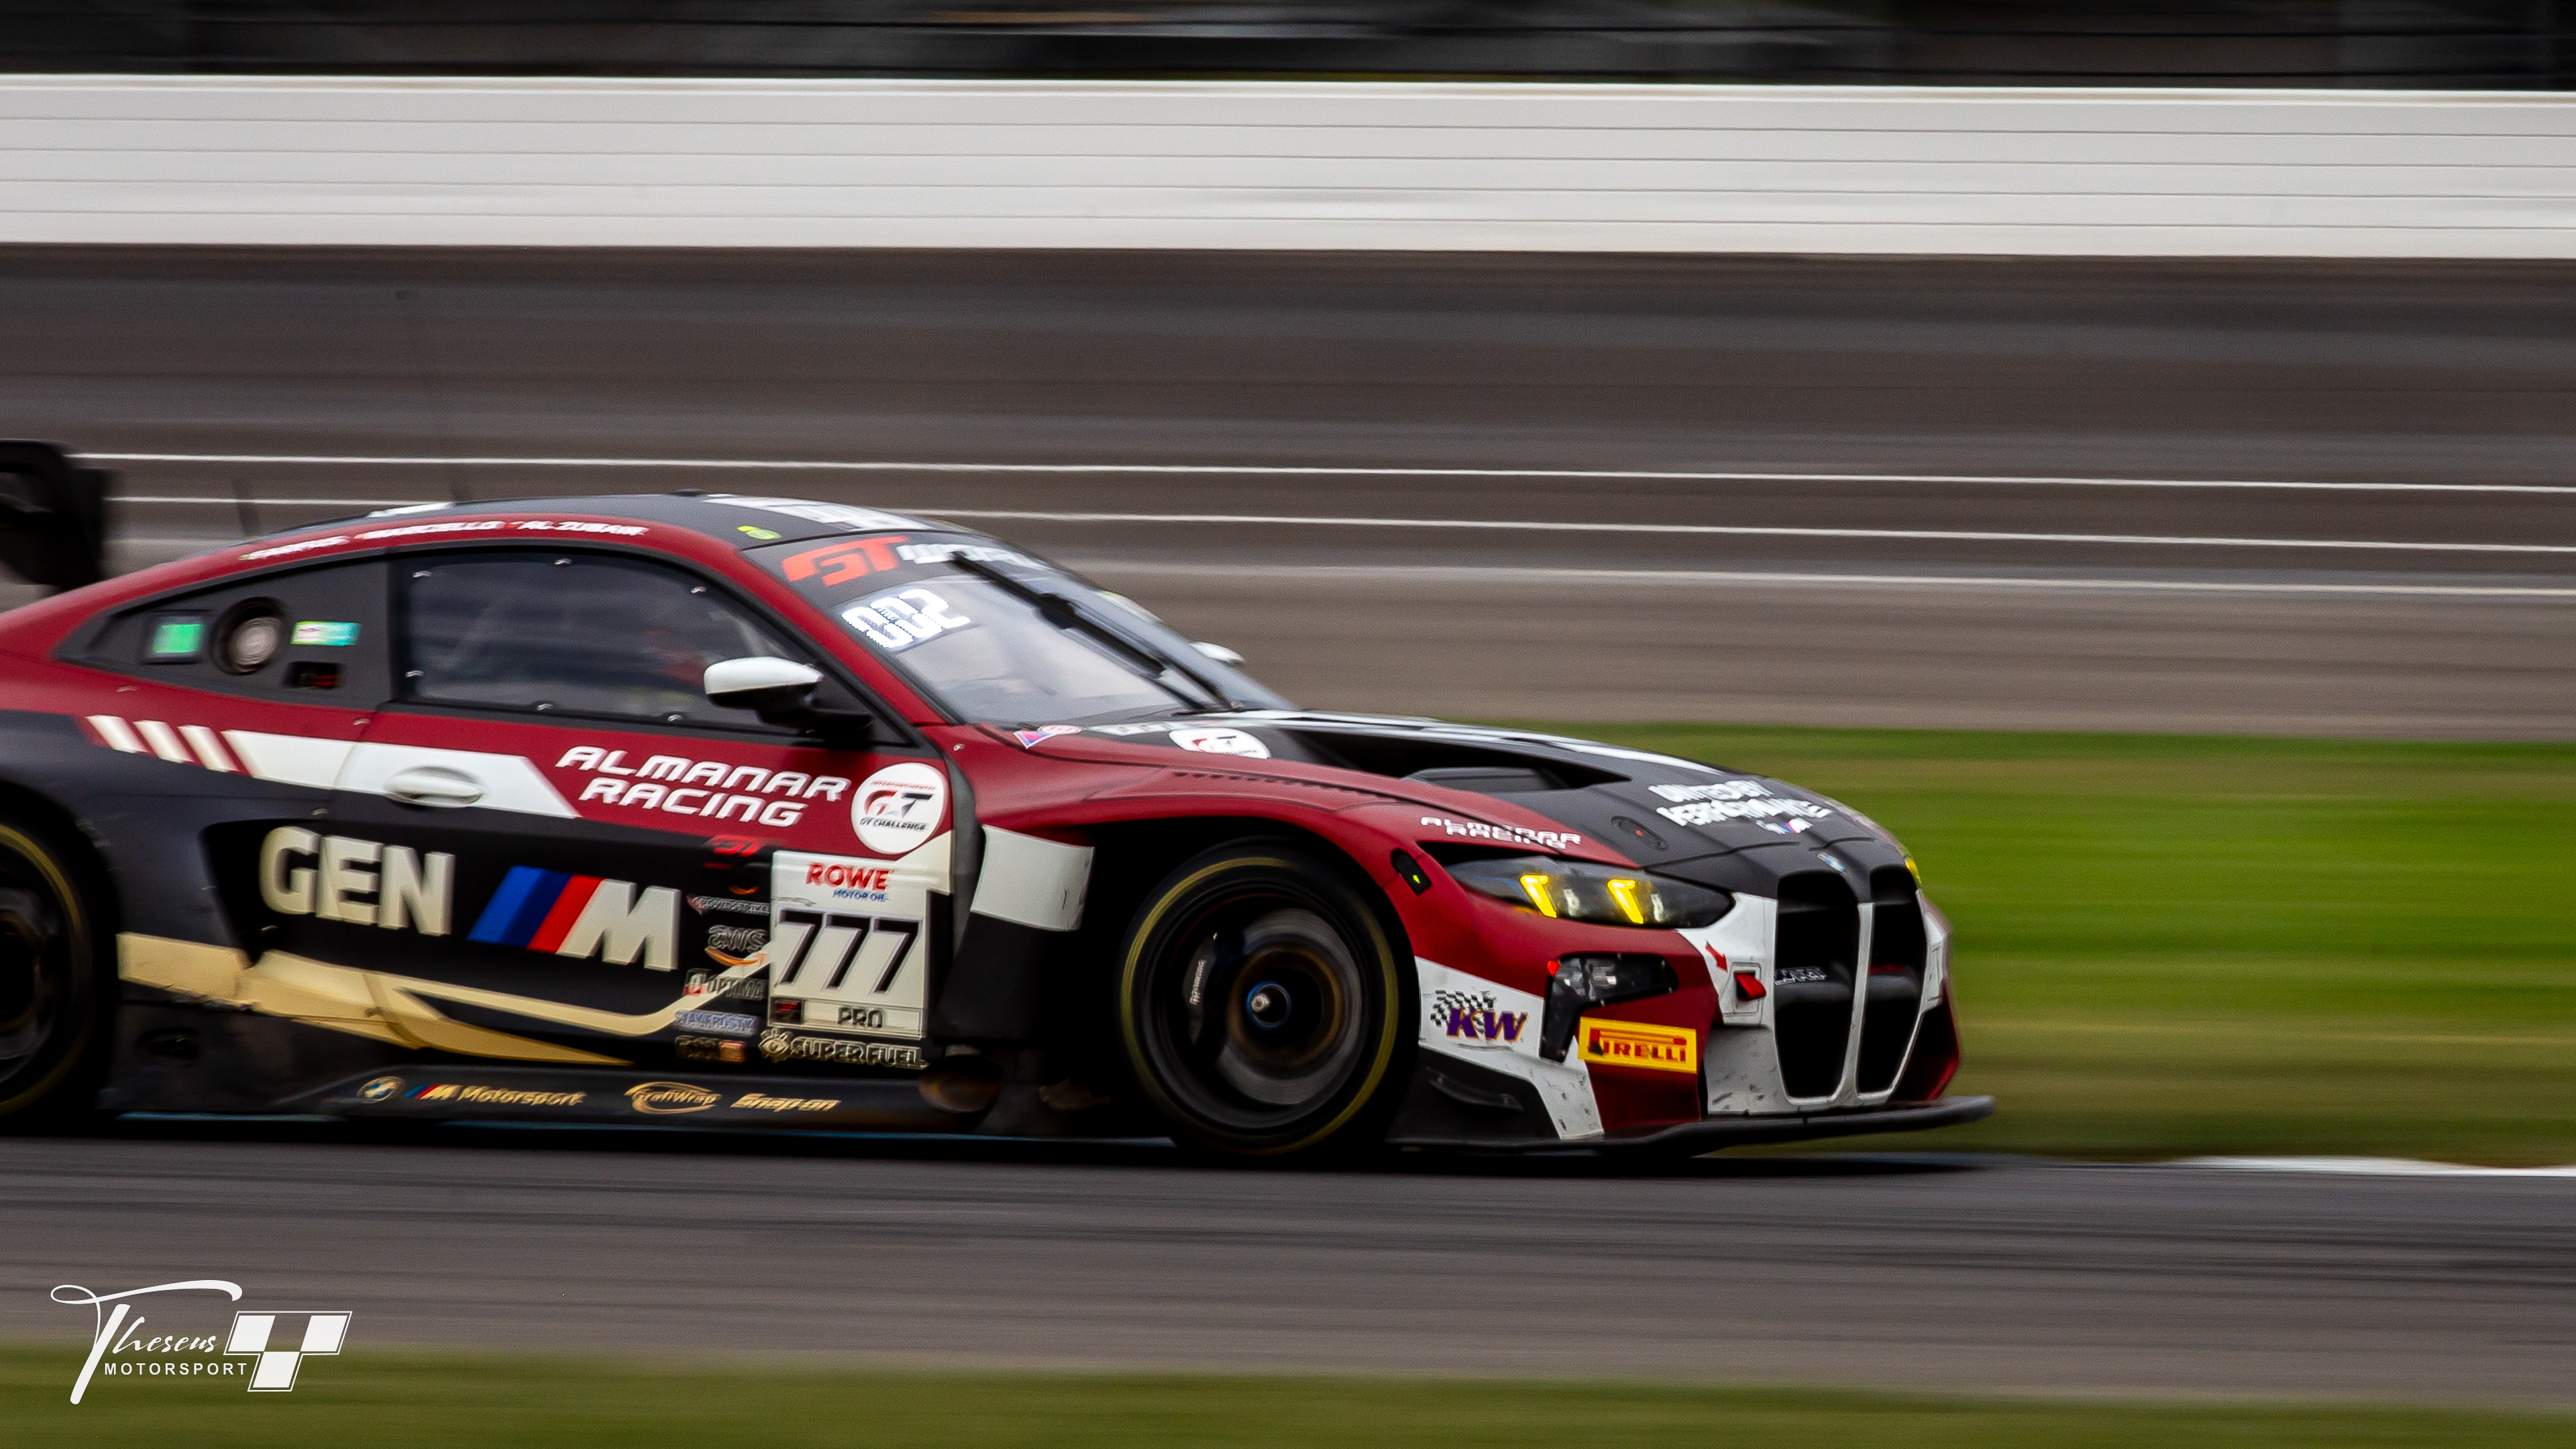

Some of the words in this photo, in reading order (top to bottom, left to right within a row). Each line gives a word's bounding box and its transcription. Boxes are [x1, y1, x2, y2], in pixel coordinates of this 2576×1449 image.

[782, 536, 911, 586] GT
[555, 745, 851, 802] ALMANAR
[579, 777, 809, 827] RACING
[872, 818, 928, 832] CHALLENGE
[805, 861, 889, 891] ROWE
[832, 888, 869, 900] MOTOR
[259, 826, 455, 936] GEN
[555, 878, 681, 971] M
[778, 908, 923, 996] 777
[837, 1006, 883, 1028] PRO
[1446, 1006, 1529, 1044] KW
[1588, 1027, 1687, 1063] PIRELLI
[457, 1085, 588, 1106] Motorsport
